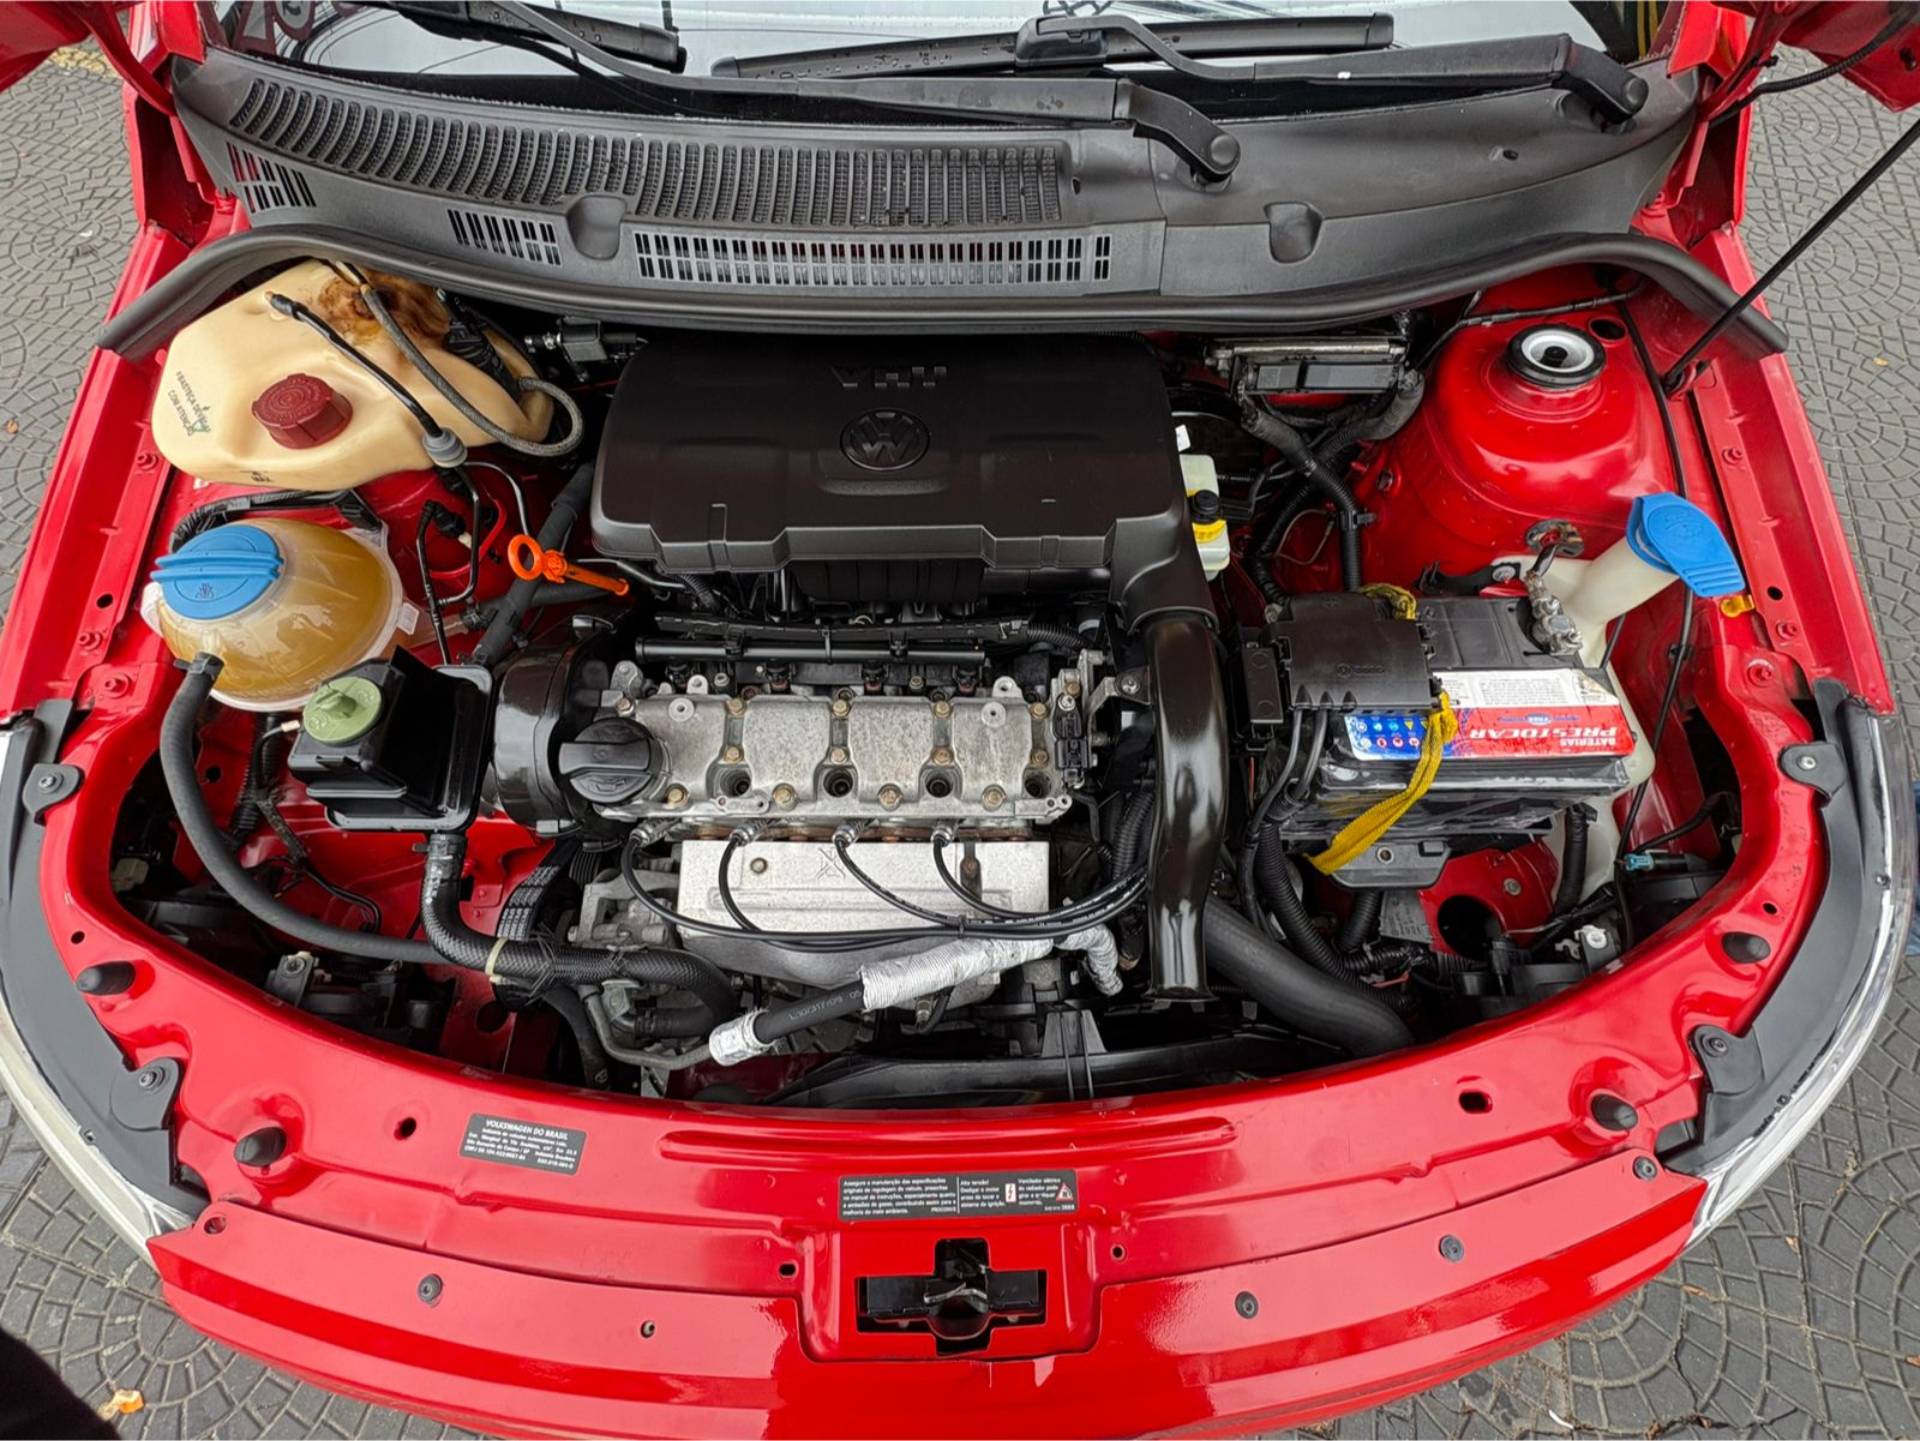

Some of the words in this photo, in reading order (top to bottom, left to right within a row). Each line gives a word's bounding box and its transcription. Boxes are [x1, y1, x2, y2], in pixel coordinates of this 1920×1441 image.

[843, 410, 927, 469] VW
[1468, 726, 1618, 740] PRESTOCAR
[1559, 737, 1616, 747] BATERIAS
[486, 1119, 532, 1133] VOLKSWAGEN
[533, 1127, 545, 1136] DO
[545, 1129, 568, 1140] BRASIL
